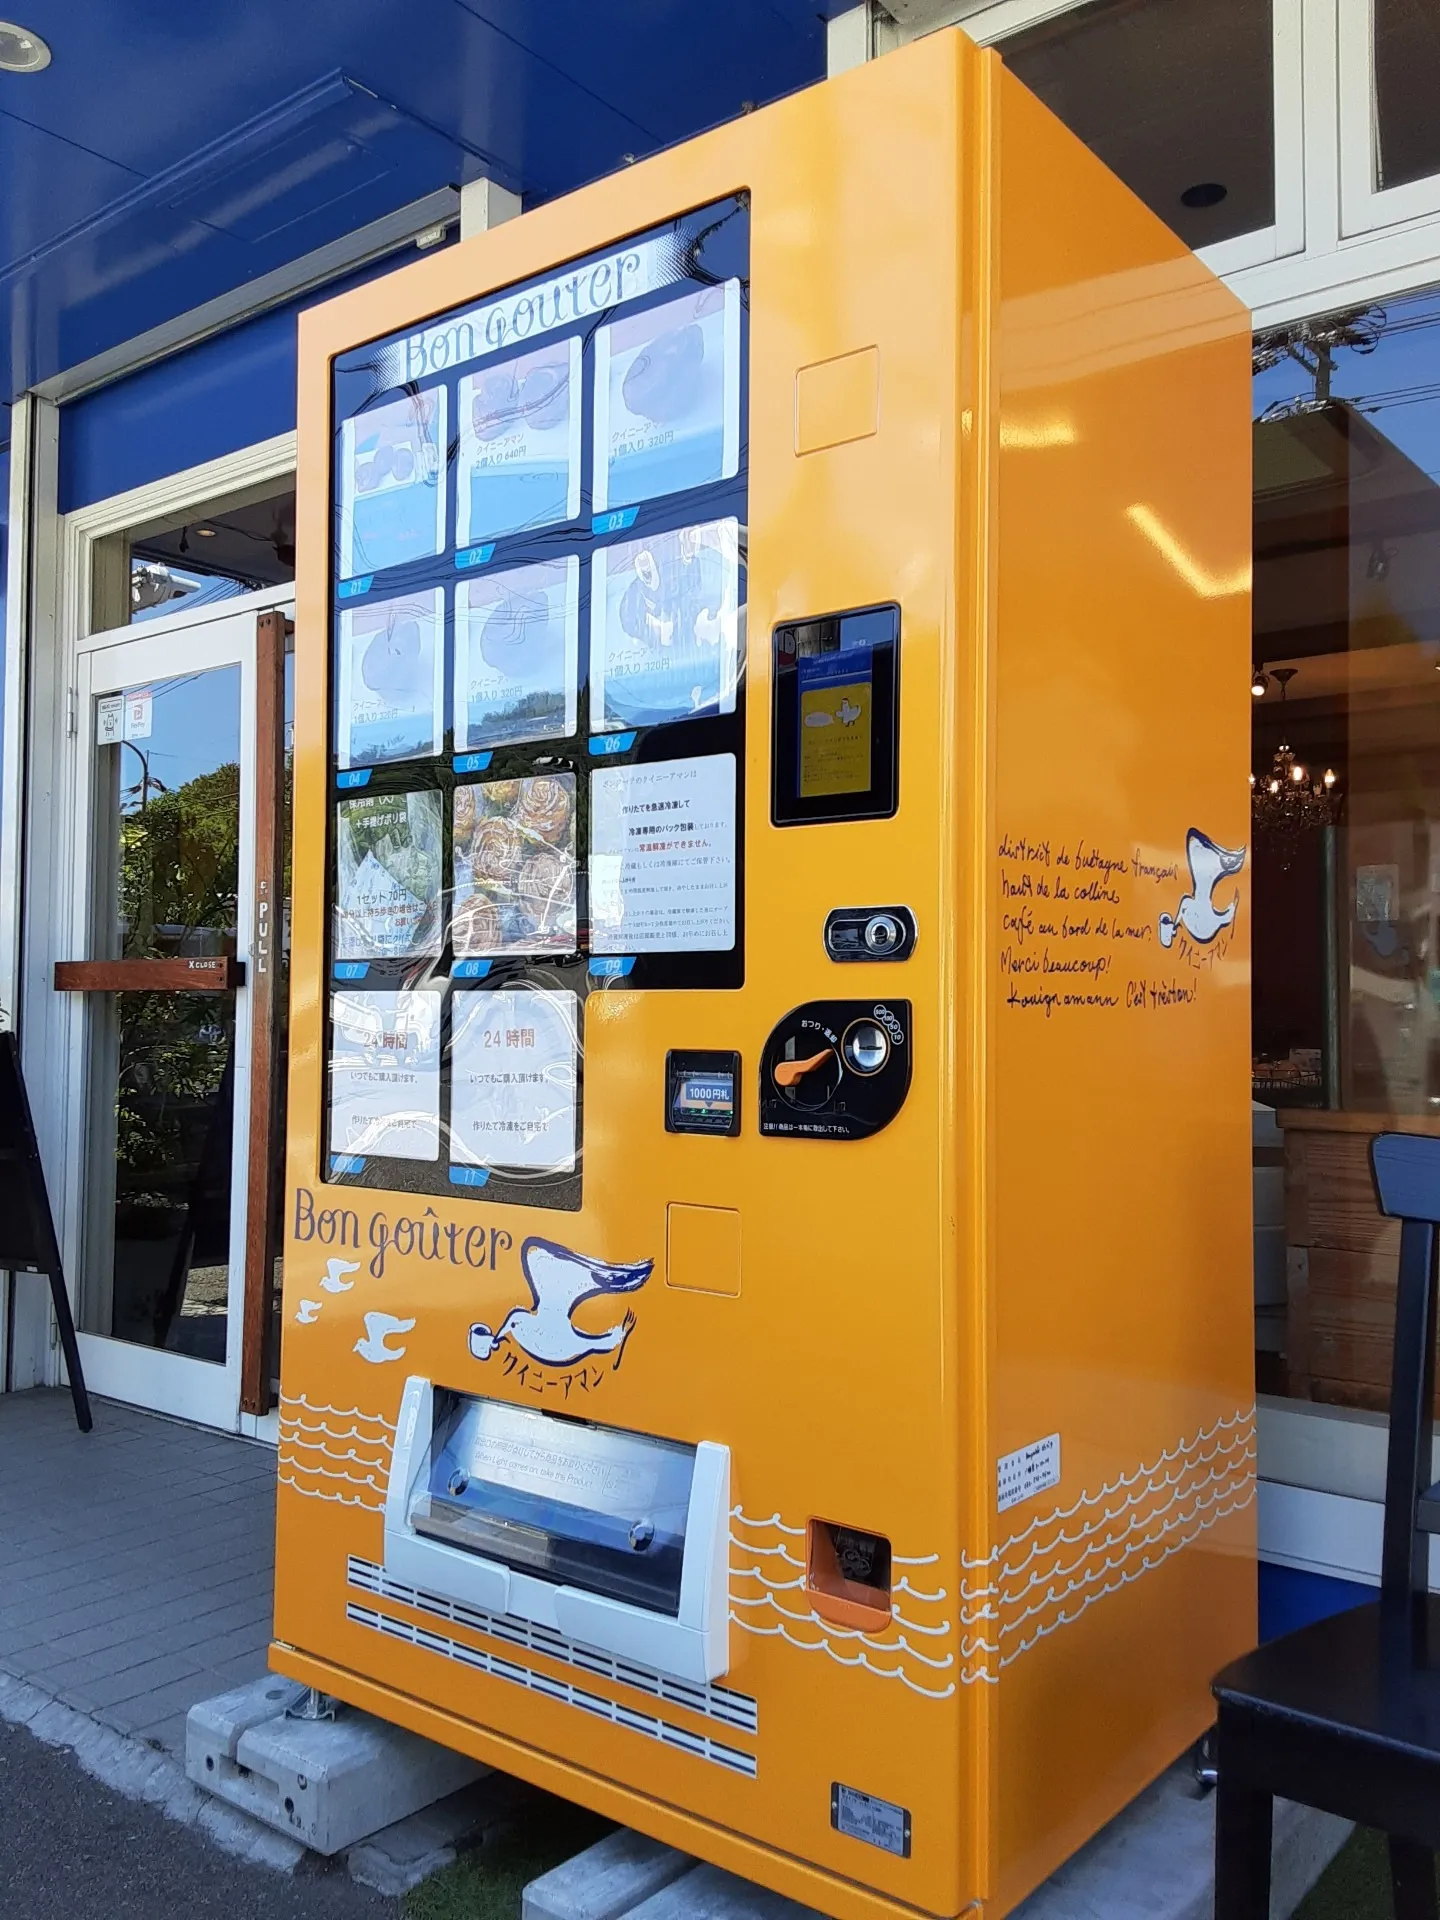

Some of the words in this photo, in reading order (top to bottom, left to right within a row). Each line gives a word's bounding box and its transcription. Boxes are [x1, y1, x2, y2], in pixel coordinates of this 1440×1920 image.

[608, 512, 624, 529] 03
[350, 581, 361, 593] 01
[605, 737, 620, 753] 06
[467, 756, 479, 769] 05
[1056, 846, 1070, 865] de
[1037, 875, 1050, 898] de
[1054, 876, 1069, 899] la
[1074, 881, 1120, 904] colline
[1003, 905, 1034, 945] café
[1095, 917, 1108, 936] de
[1112, 918, 1124, 939] la
[258, 902, 268, 973] PULL
[605, 960, 621, 973] 09
[1001, 946, 1039, 974] Merci
[346, 965, 358, 977] 07
[466, 963, 479, 976] 08
[382, 1032, 408, 1050] 時間
[483, 1030, 501, 1048] 24
[506, 1028, 535, 1048] 時間
[470, 1073, 549, 1084] いつでもご購入頂けます。
[690, 1088, 730, 1100] 1000円札
[464, 1170, 476, 1184] 11
[294, 1188, 361, 1249] Bon
[368, 1206, 514, 1279] goûter
[502, 1351, 605, 1401] クイニーアマン
